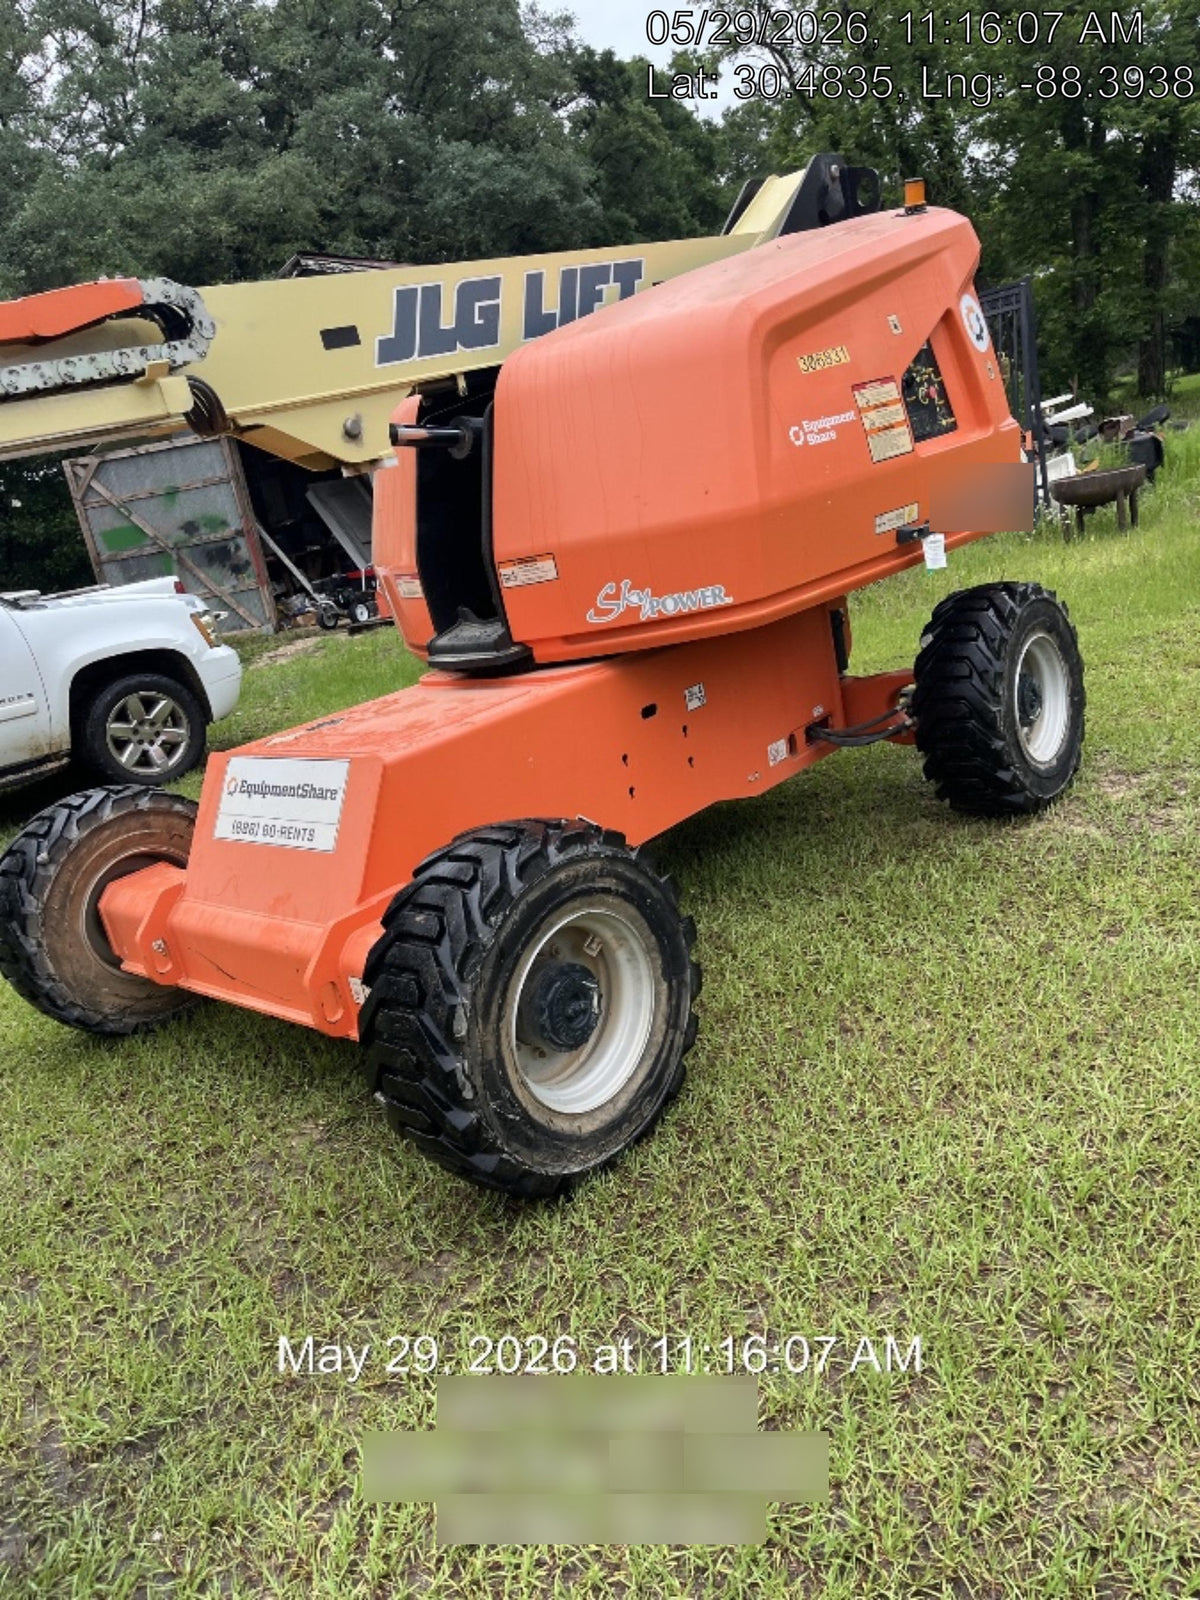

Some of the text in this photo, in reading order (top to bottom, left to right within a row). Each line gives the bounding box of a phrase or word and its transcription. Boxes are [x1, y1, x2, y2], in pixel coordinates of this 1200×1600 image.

[375, 258, 645, 368] JLG LIFT
[802, 410, 856, 432] Equipment
[239, 779, 338, 800] EquipmentShare
